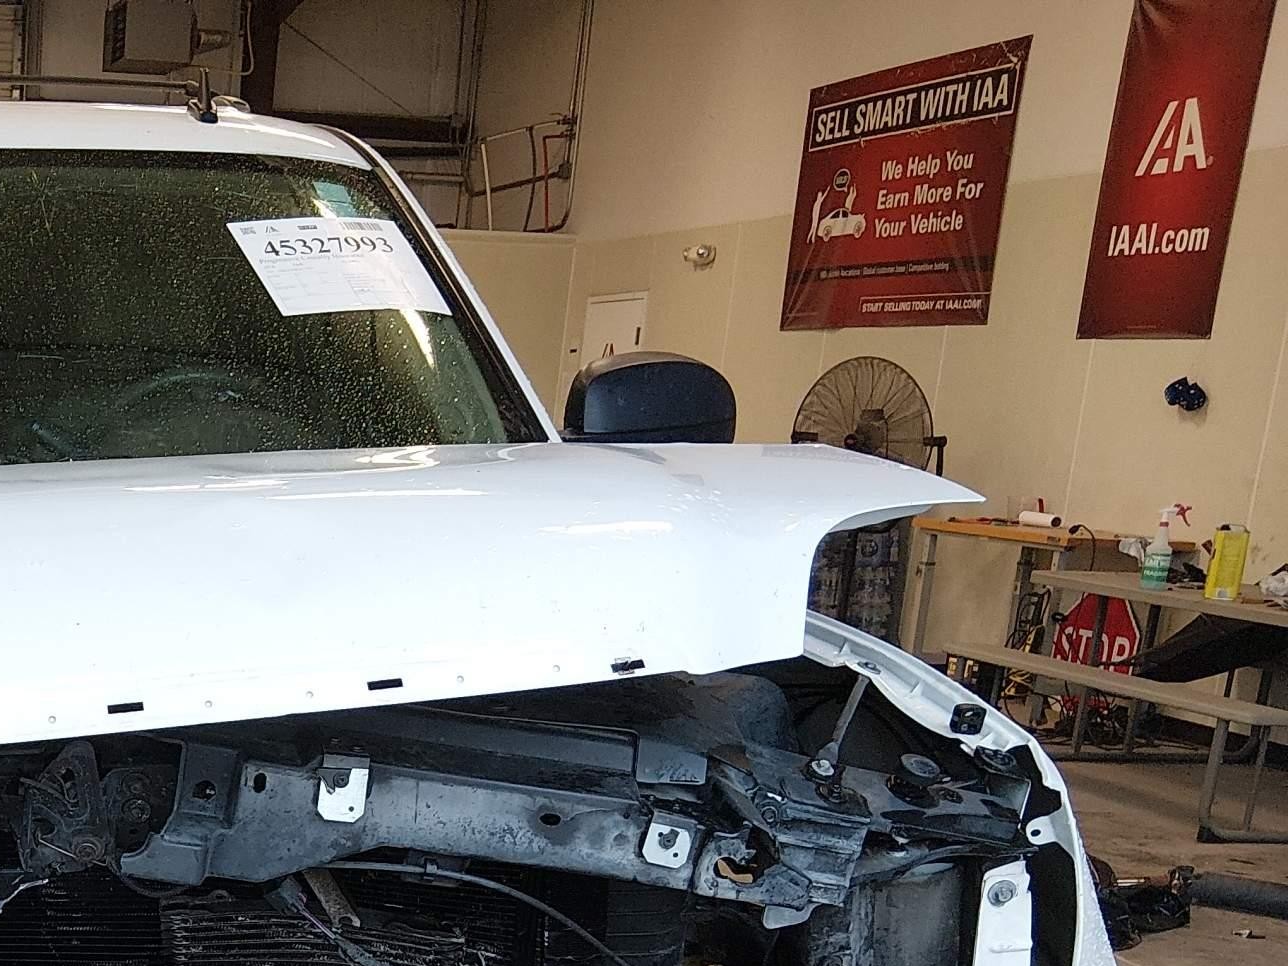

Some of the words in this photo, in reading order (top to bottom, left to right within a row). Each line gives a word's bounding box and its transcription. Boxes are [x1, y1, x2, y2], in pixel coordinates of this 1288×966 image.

[816, 108, 851, 142] SELL
[854, 93, 917, 134] SMART
[920, 83, 971, 120] WITH
[972, 74, 1009, 111] IAA
[882, 160, 903, 181] We
[907, 154, 941, 179] Help
[946, 150, 974, 172] You
[876, 189, 910, 210] Earn
[913, 183, 952, 206] More
[956, 179, 985, 201] For
[874, 217, 907, 238] Your
[911, 210, 964, 235] Vehicle
[264, 236, 394, 256] 45327993
[1107, 223, 1210, 257] IAAI.com
[862, 302, 883, 313] START
[884, 300, 911, 312] SELLING
[911, 300, 934, 312] TODAY
[934, 300, 945, 310] AT
